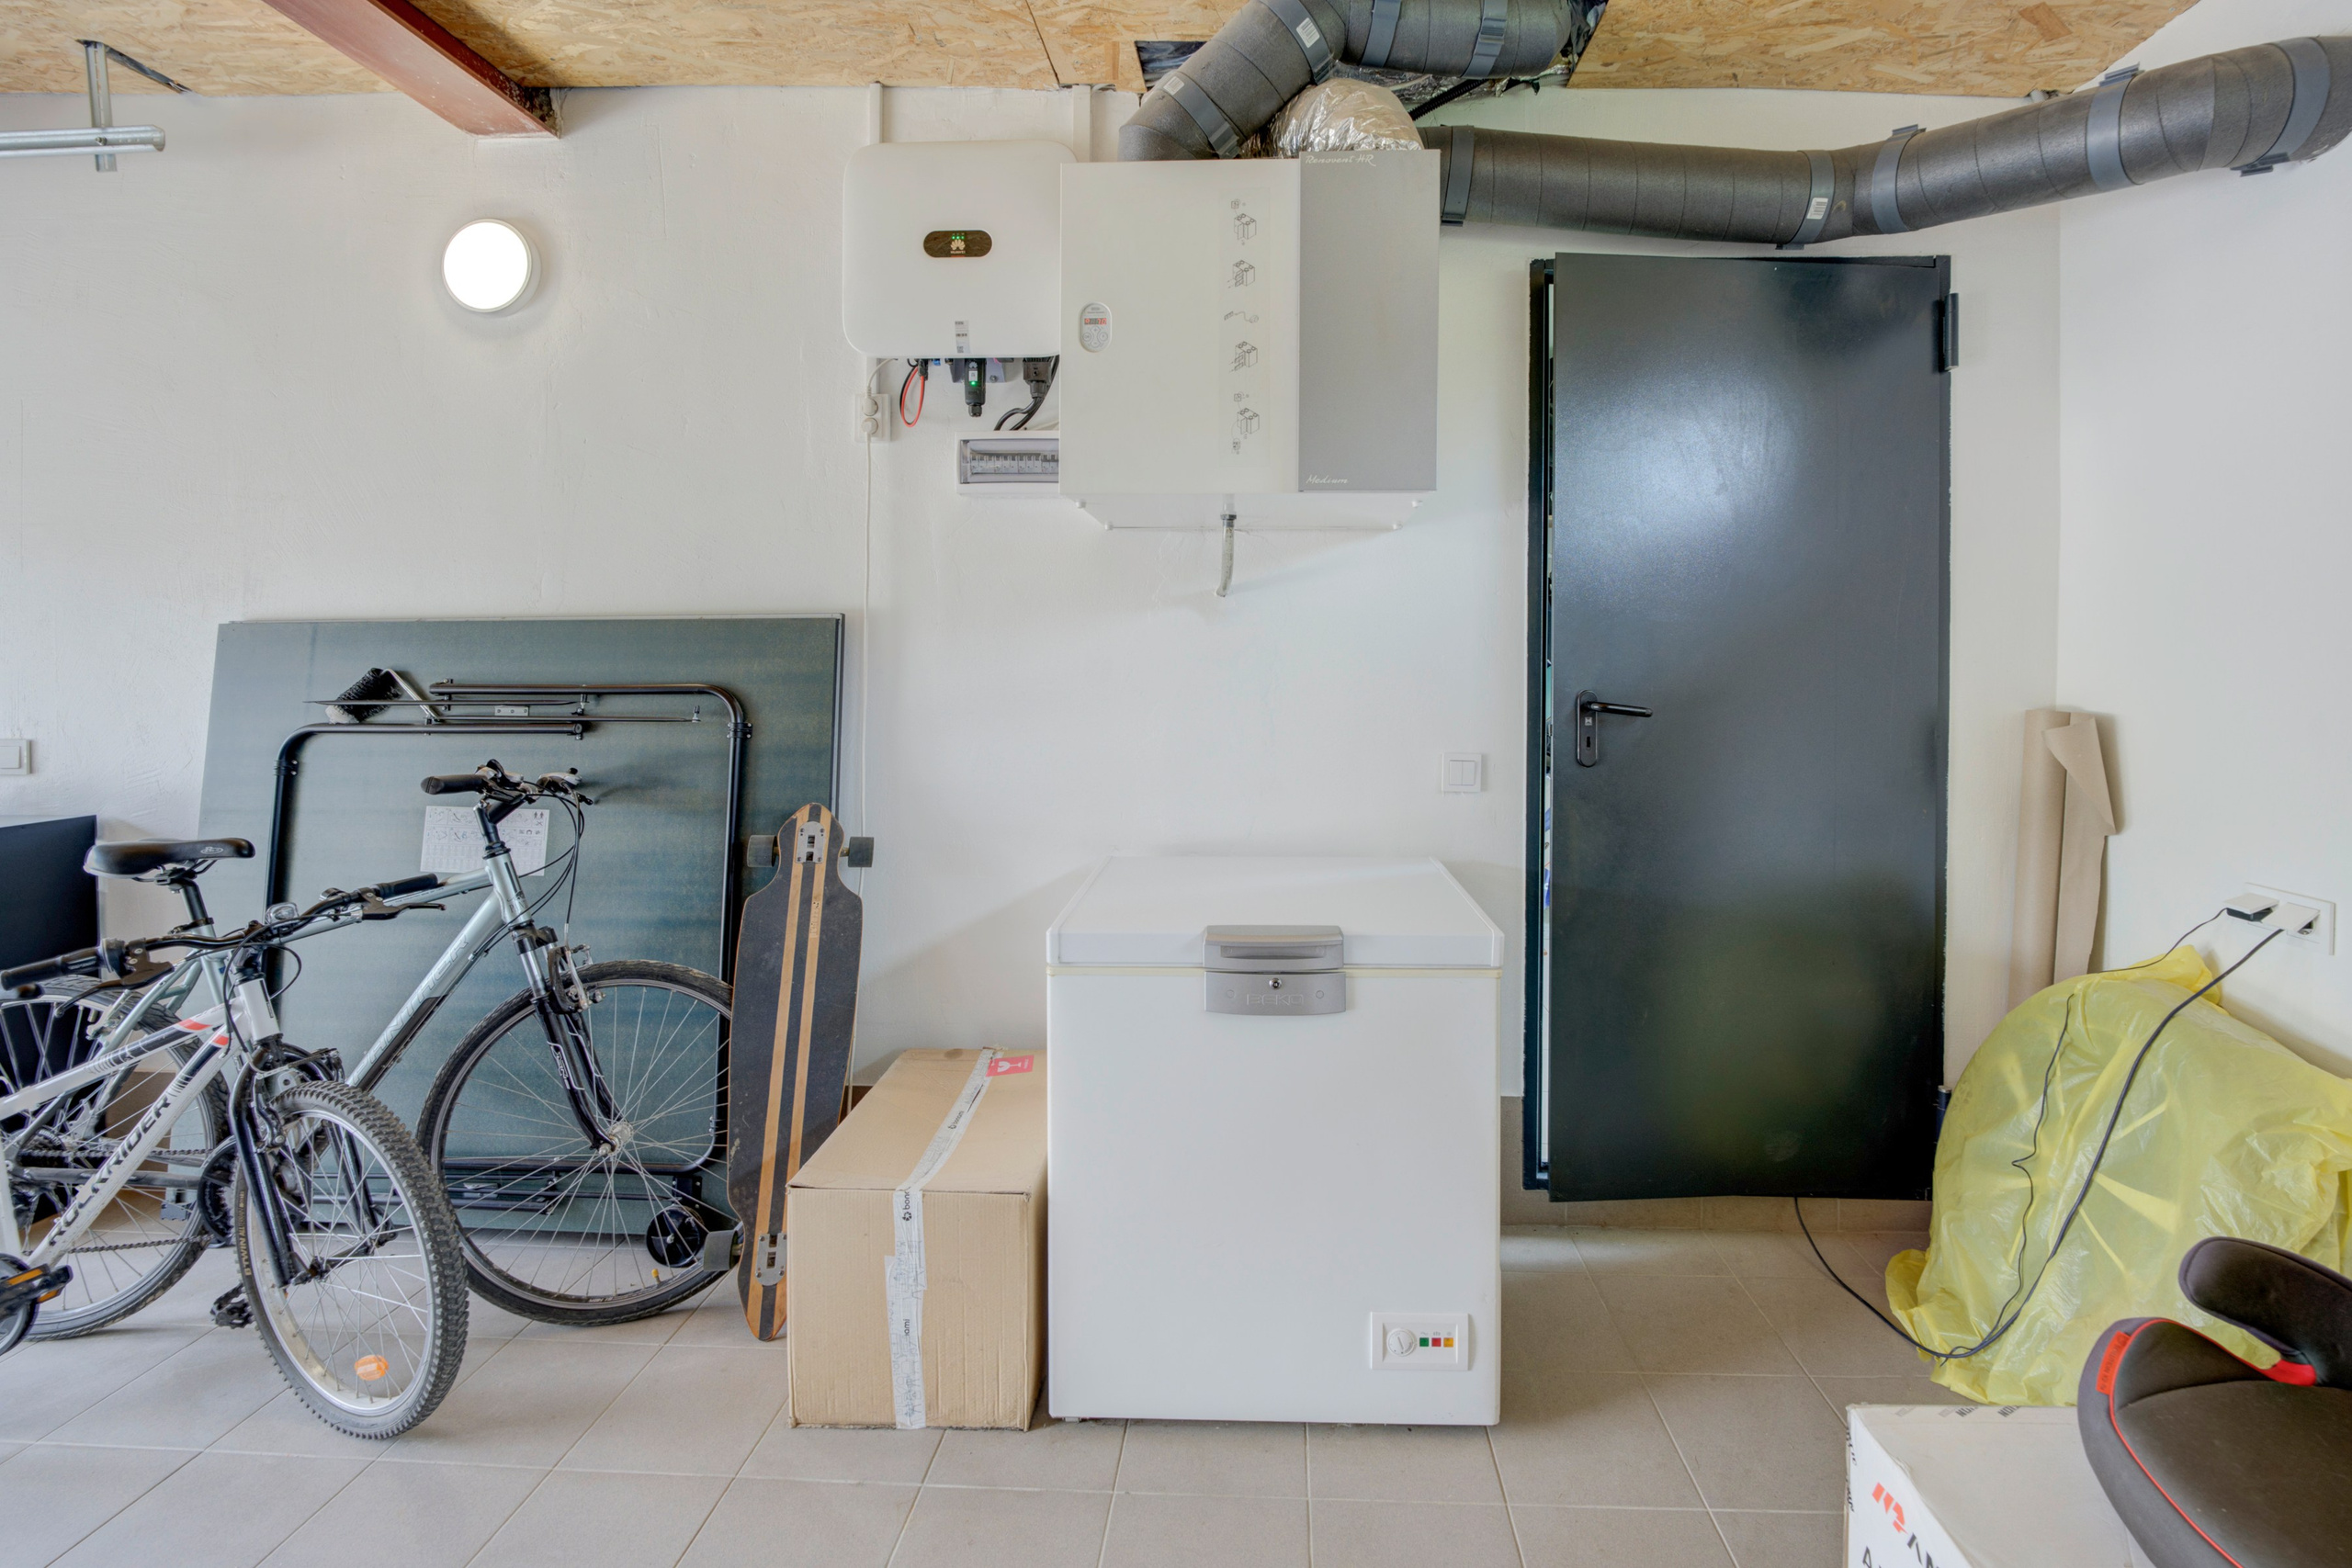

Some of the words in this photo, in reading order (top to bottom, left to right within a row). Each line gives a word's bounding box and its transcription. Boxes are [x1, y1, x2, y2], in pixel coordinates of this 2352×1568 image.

[1306, 154, 1355, 164] Renovent
[1306, 474, 1348, 484] Medium
[352, 933, 469, 1087] PANTHER
[48, 1095, 171, 1247] ROCKRIDER
